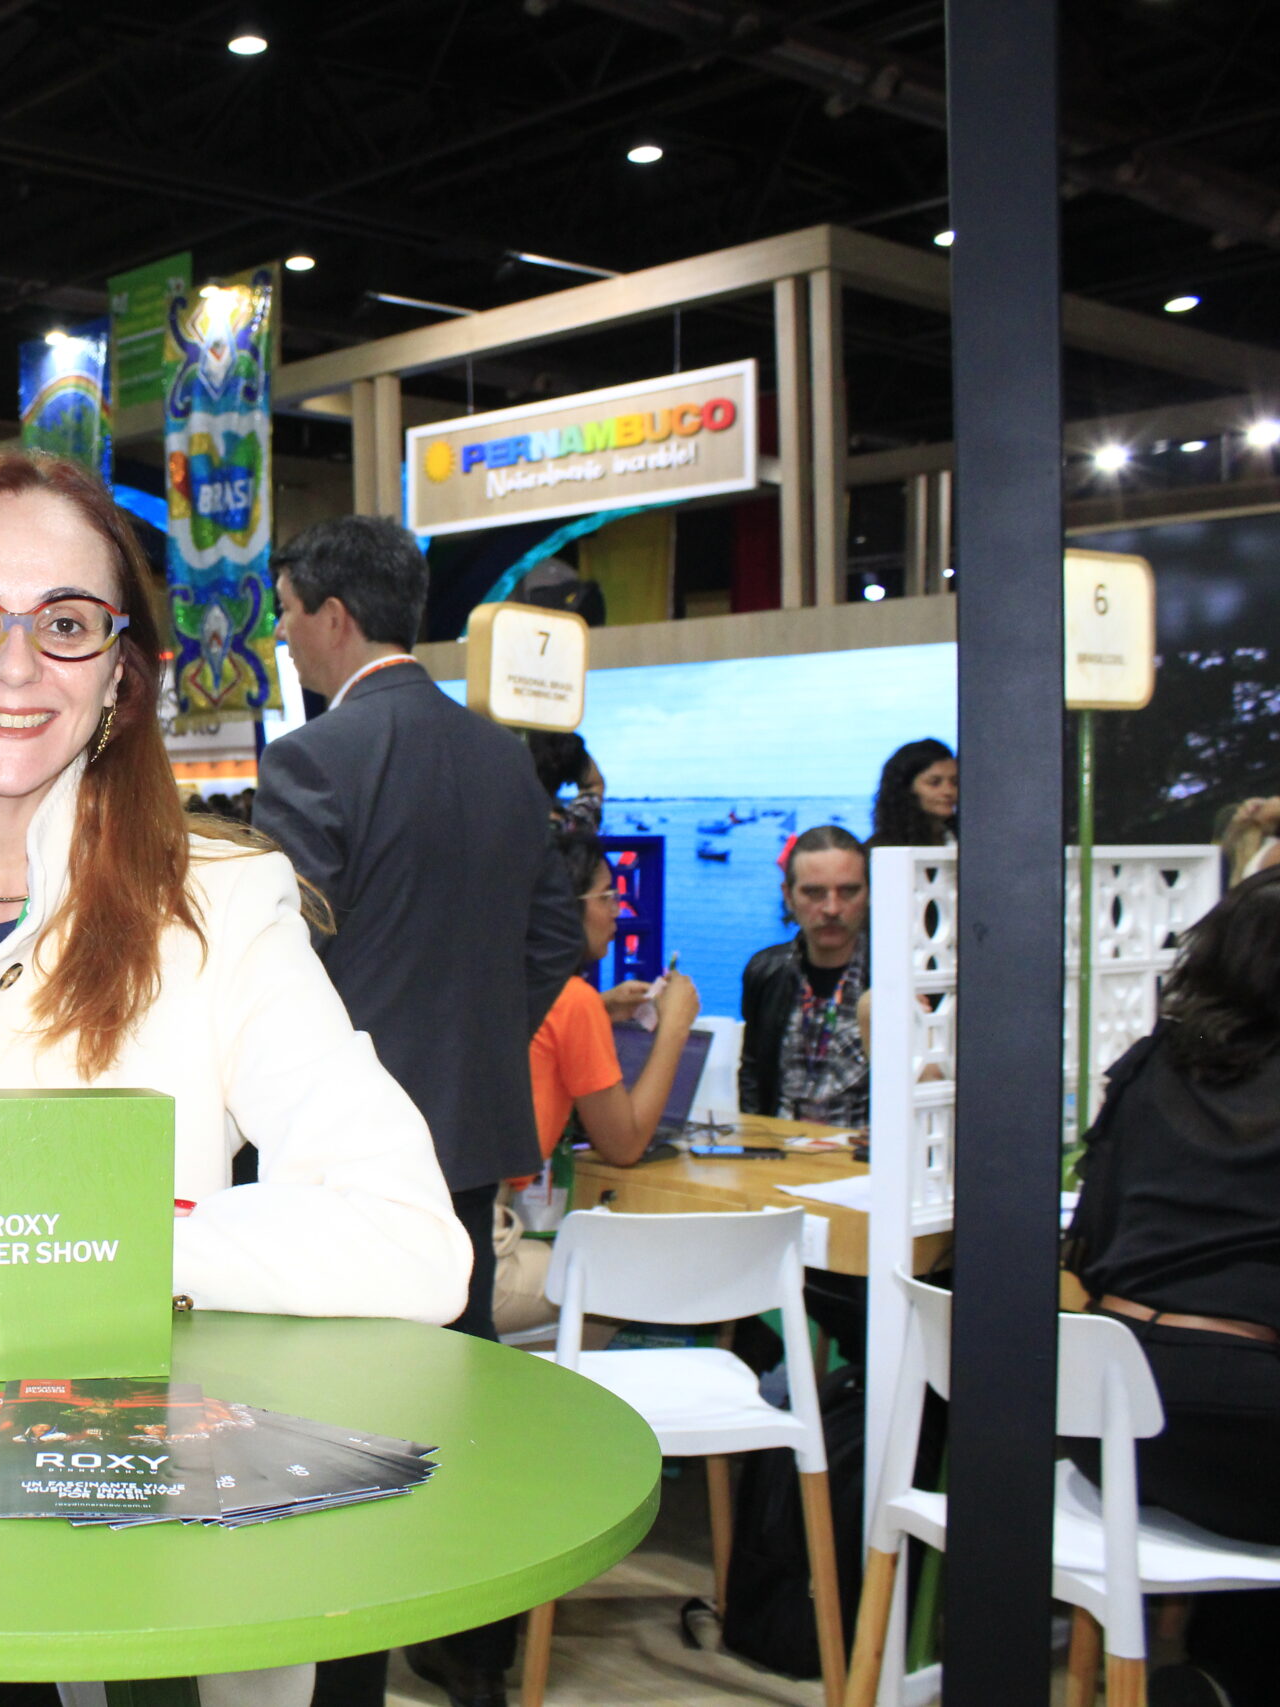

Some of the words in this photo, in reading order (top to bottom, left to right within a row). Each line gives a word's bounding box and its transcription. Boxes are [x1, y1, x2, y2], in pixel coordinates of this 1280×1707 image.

[462, 398, 736, 473] PERNAMBUCO
[197, 477, 256, 515] BRASI
[1093, 583, 1109, 616] 6
[537, 631, 551, 657] 7
[35, 1239, 120, 1264] SHOW
[35, 1452, 170, 1471] ROXY
[21, 1480, 42, 1488] UN
[47, 1480, 138, 1490] FASCINANTE
[142, 1482, 186, 1491] VIAJE
[26, 1486, 92, 1494] MUSICAL
[97, 1487, 182, 1496] INMERSIVO
[58, 1491, 91, 1499] POR
[96, 1492, 149, 1501] BRASIL
